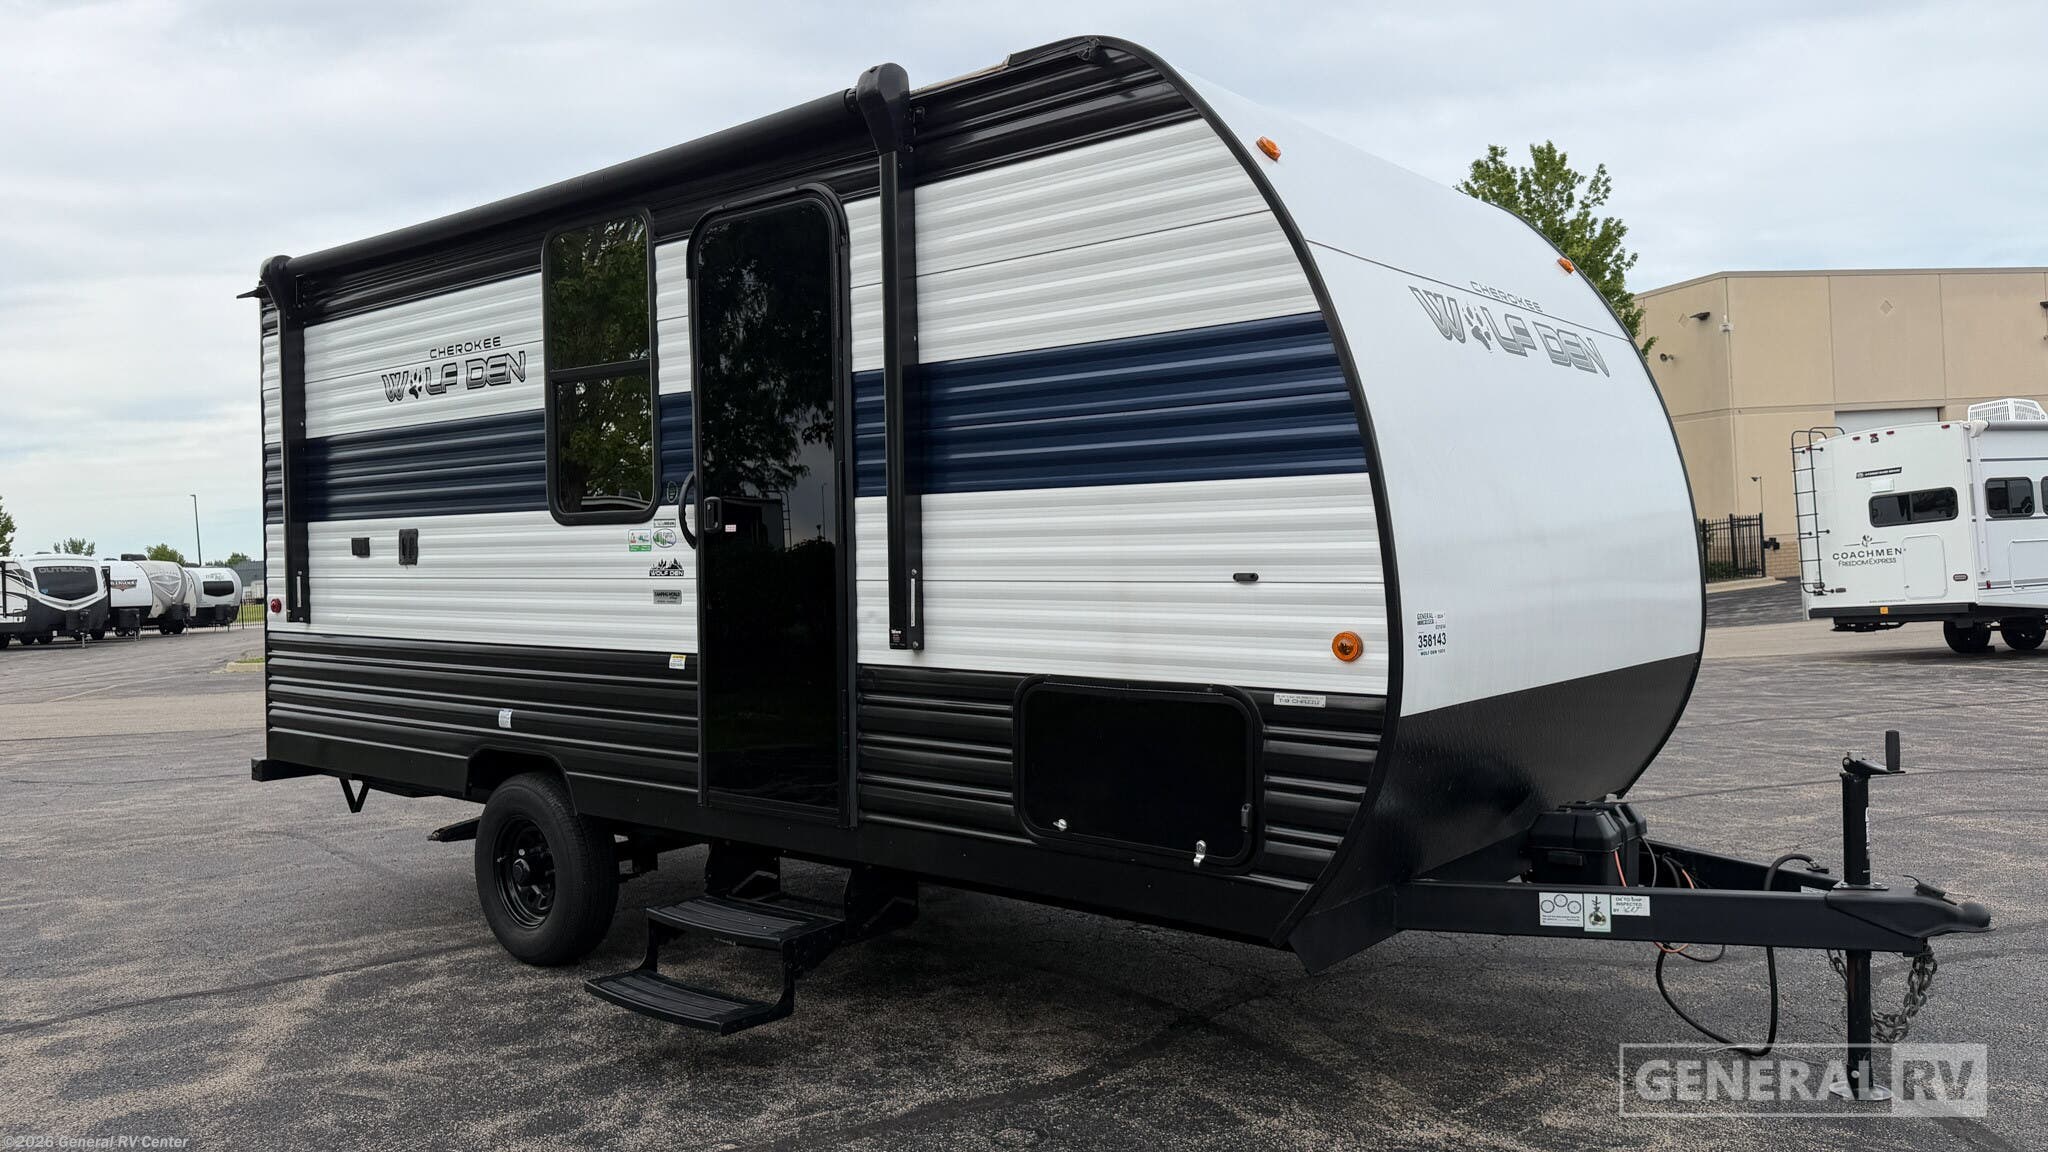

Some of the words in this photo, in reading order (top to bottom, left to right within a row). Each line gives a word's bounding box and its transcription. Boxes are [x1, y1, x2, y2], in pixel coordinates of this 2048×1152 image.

[1470, 281, 1543, 312] CHEROKEE
[430, 336, 501, 359] CHEROKEE
[1532, 321, 1610, 378] DEN
[466, 351, 526, 390] DEN
[1832, 548, 1902, 560] COACHMEN
[1418, 632, 1446, 648] 358143
